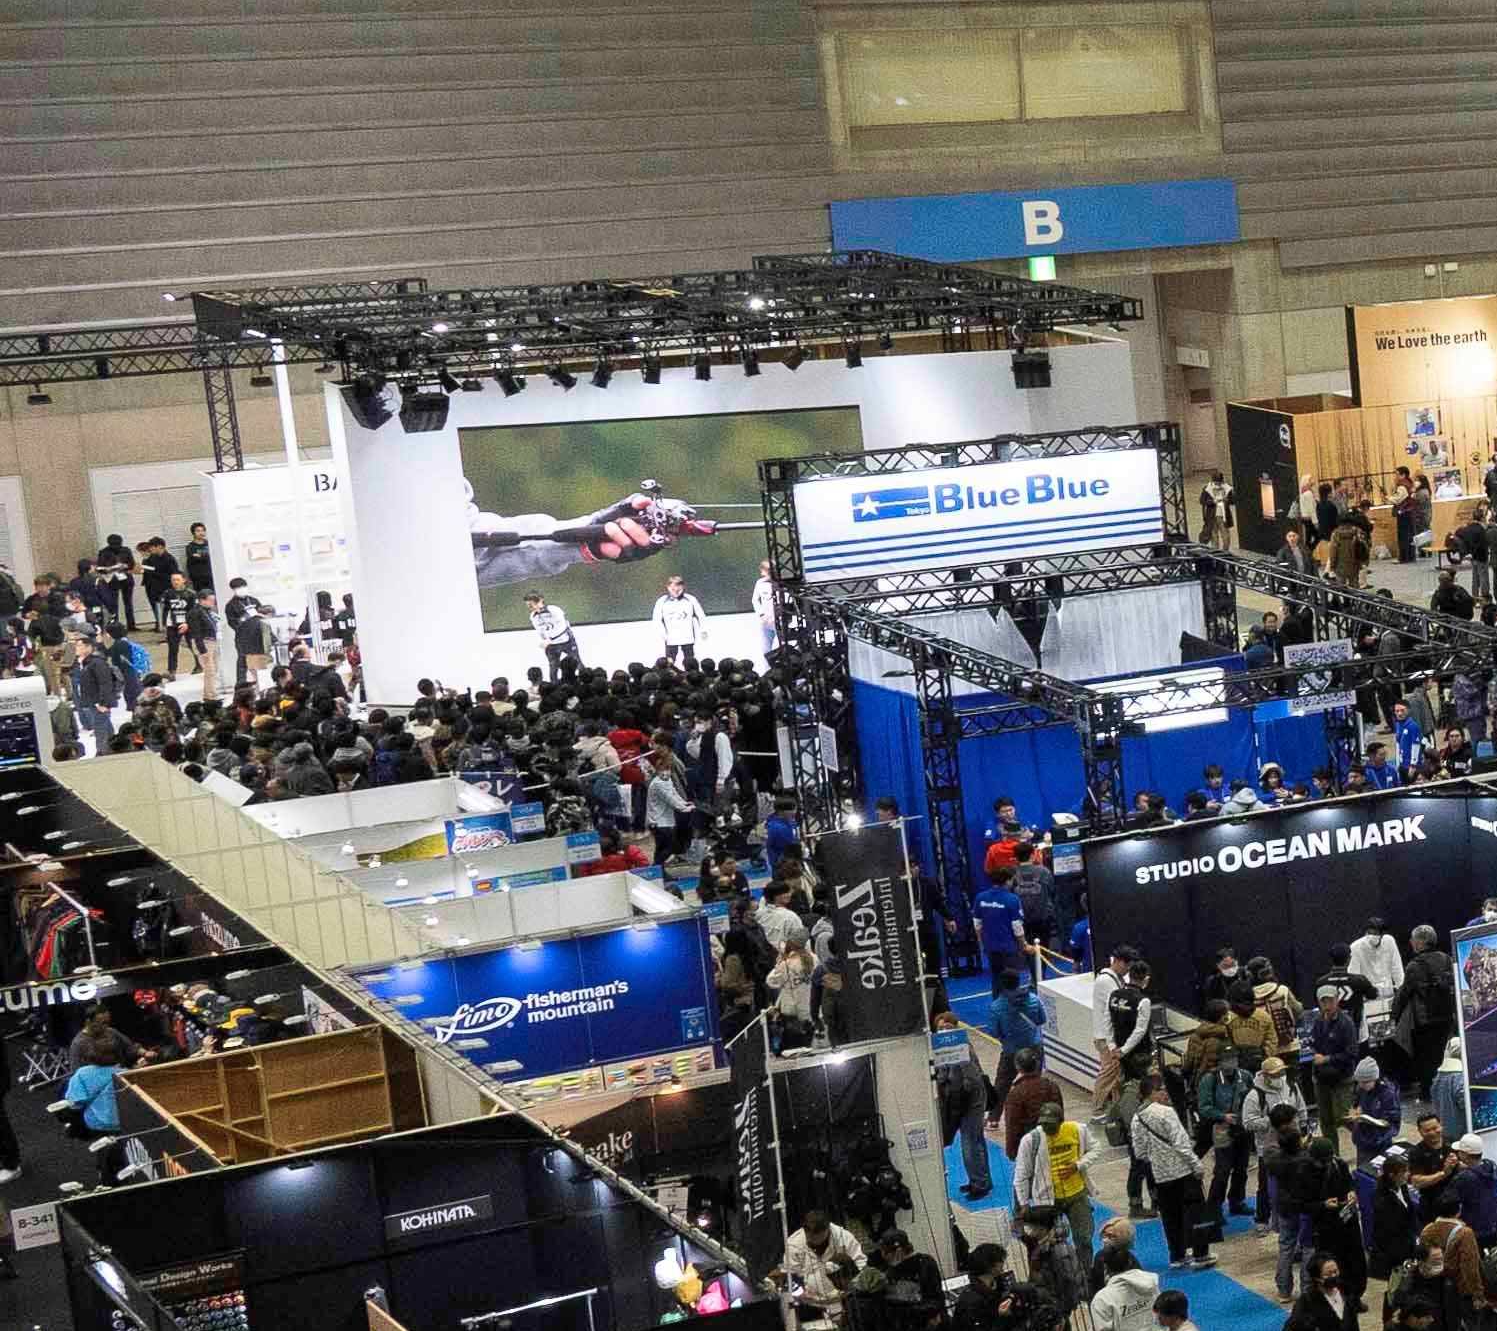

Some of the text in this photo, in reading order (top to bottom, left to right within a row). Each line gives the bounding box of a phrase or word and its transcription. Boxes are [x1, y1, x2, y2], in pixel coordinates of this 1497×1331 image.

[1023, 201, 1063, 246] B
[1375, 330, 1486, 350] We Love the earth
[935, 482, 1020, 514] Blue
[1026, 474, 1110, 504] Blue
[1136, 815, 1426, 884] STUDIO OCEAN MARK
[526, 980, 629, 1009] fisherman's
[527, 998, 614, 1024] mountain
[435, 997, 522, 1042] fimo
[401, 1205, 476, 1231] KOHINATA
